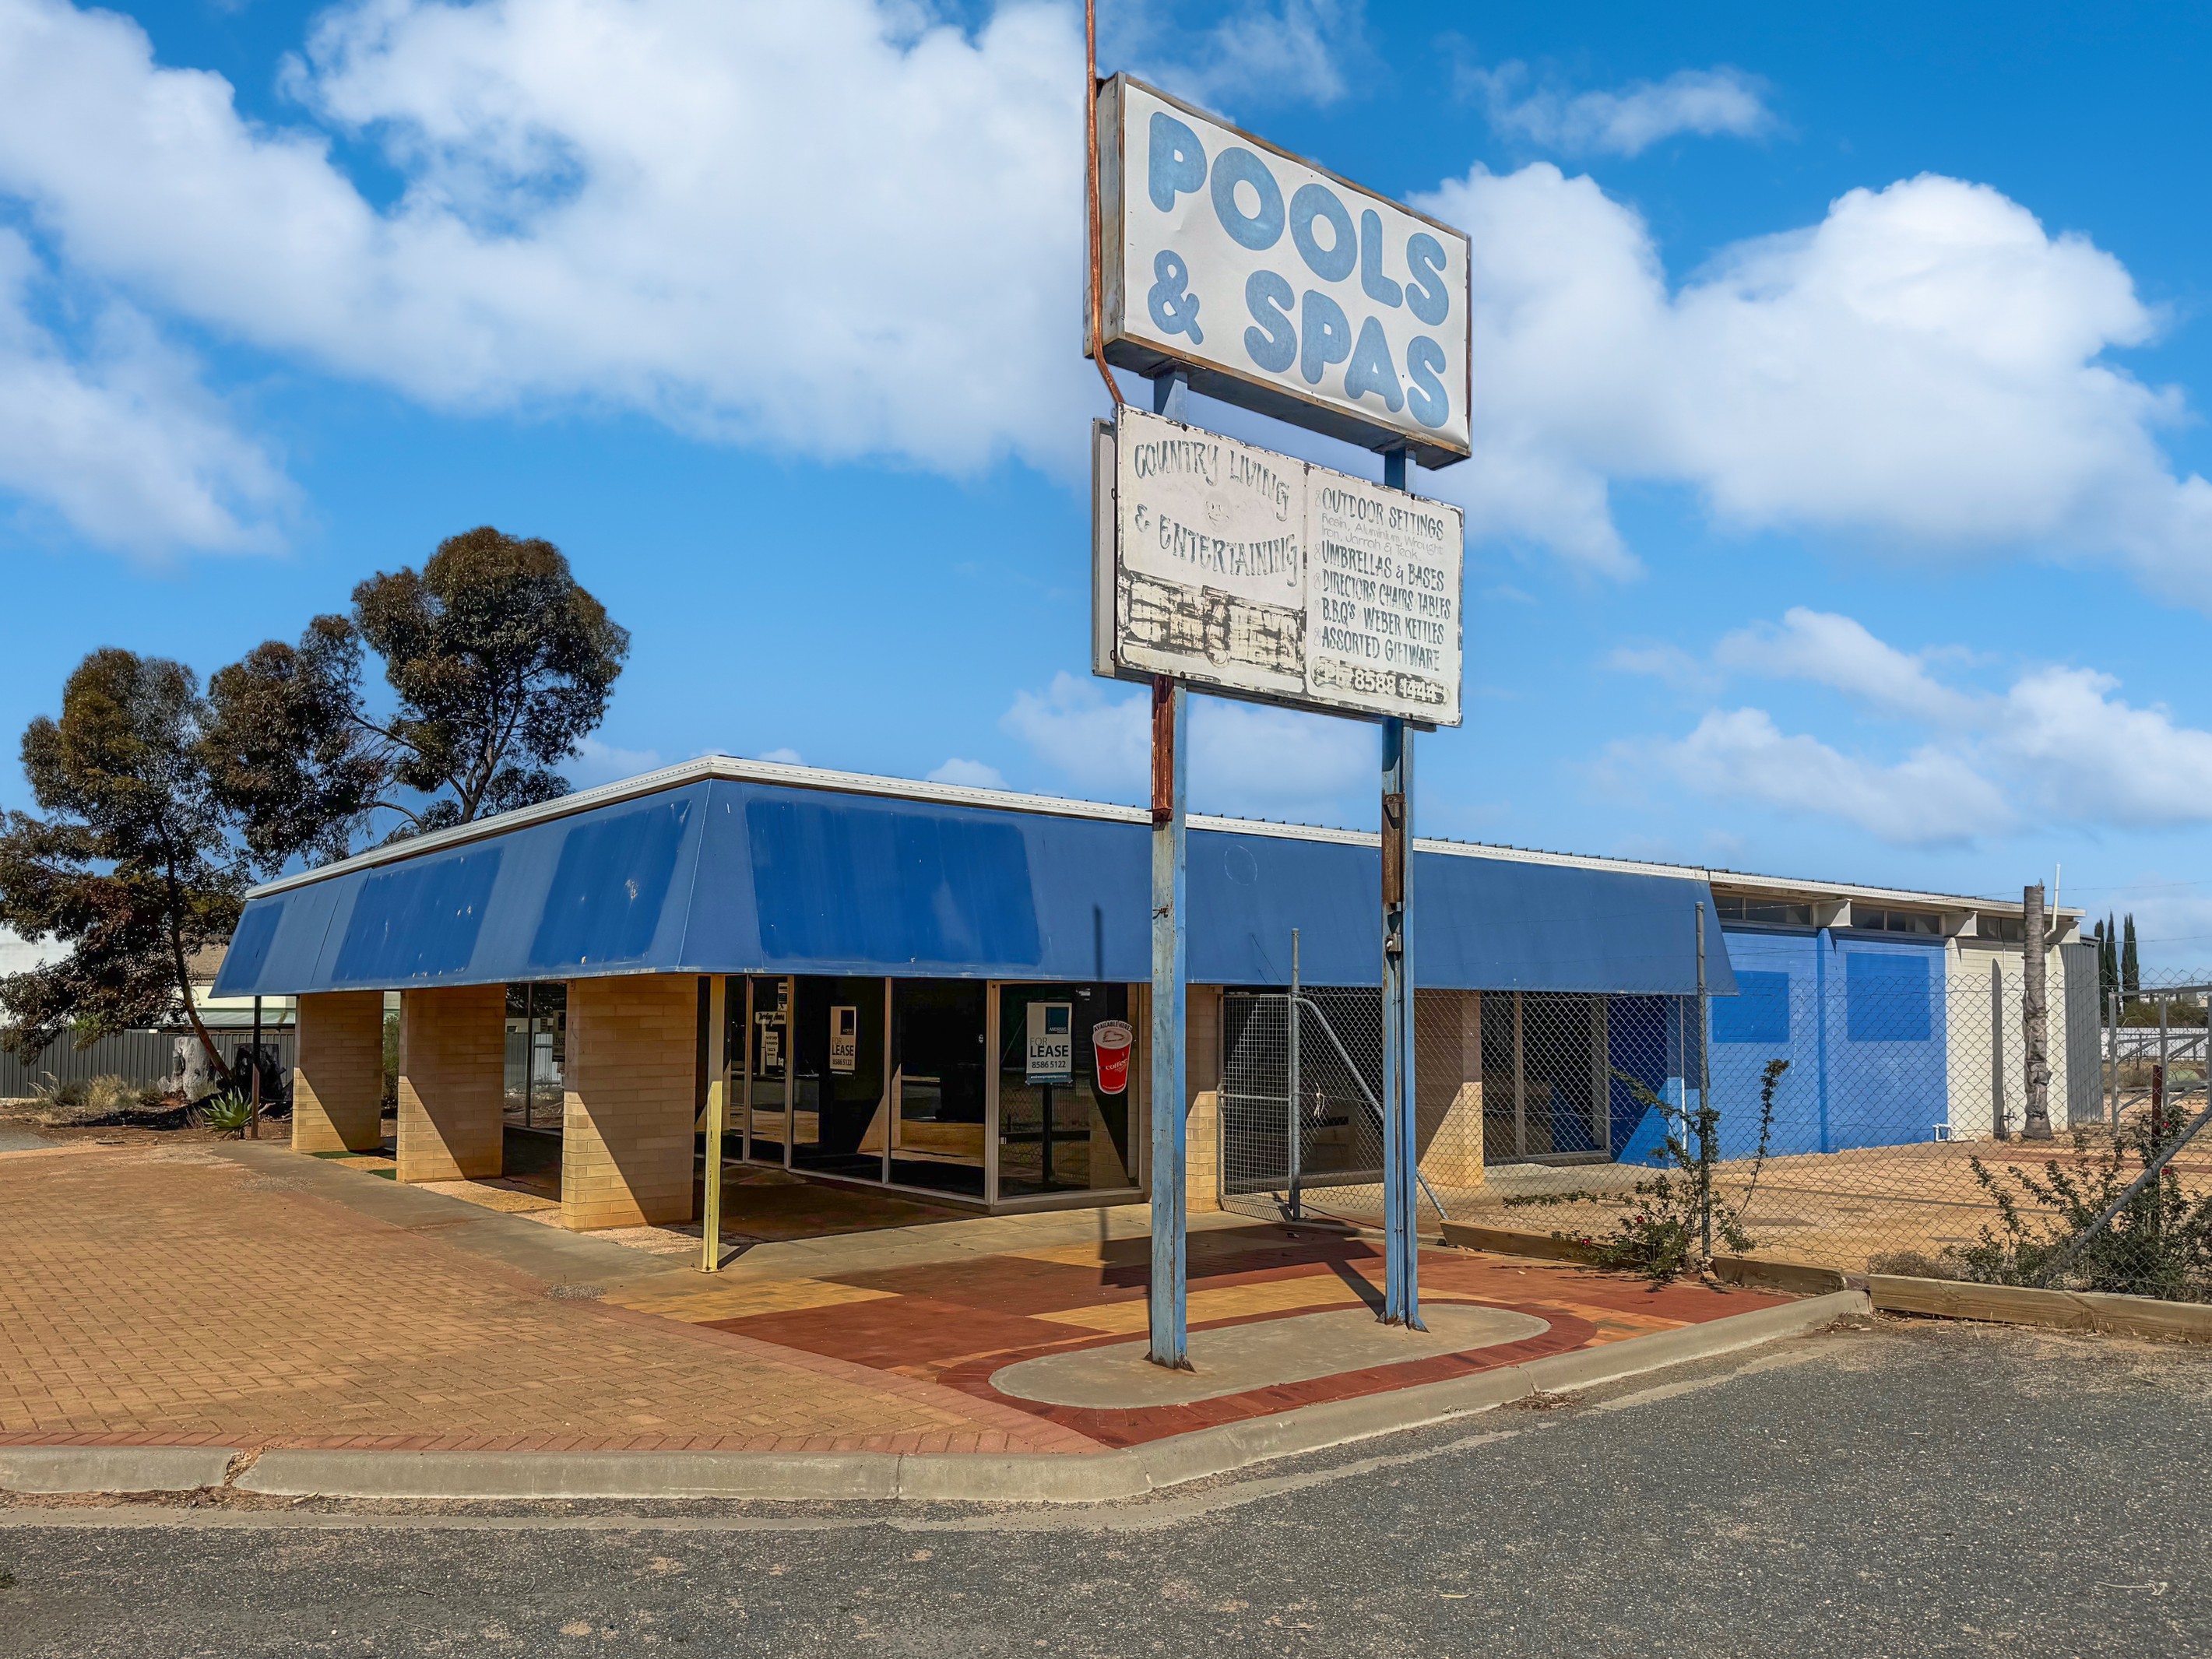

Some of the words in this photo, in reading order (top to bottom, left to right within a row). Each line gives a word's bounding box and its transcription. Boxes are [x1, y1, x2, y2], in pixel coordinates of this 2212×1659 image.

[1148, 111, 1449, 326] POOLS
[1148, 250, 1204, 345] &
[1244, 270, 1449, 428] SPAS
[1134, 439, 1219, 487] COUNTRY
[1229, 449, 1289, 522] LIVING
[1322, 487, 1384, 525] OUTDOOR
[1389, 506, 1444, 540] SETTINGS
[1159, 513, 1298, 587] ENTERTAINING
[1322, 540, 1392, 578] UMBRELLAS
[1408, 563, 1444, 592] BASES
[1322, 568, 1376, 603] DIRECTORS
[1380, 583, 1414, 612] CHAIRS
[1418, 592, 1451, 620] TABLES
[1321, 626, 1380, 658] ASSORTED
[1385, 639, 1440, 671] GIFTWARE
[1363, 606, 1401, 636] WEBER
[1405, 617, 1444, 645] KETTLES
[832, 1045, 854, 1056] LEASE
[1030, 1037, 1048, 1046] FOR
[1030, 1045, 1069, 1057] LEASE
[1094, 1021, 1118, 1032] AVAILABLE
